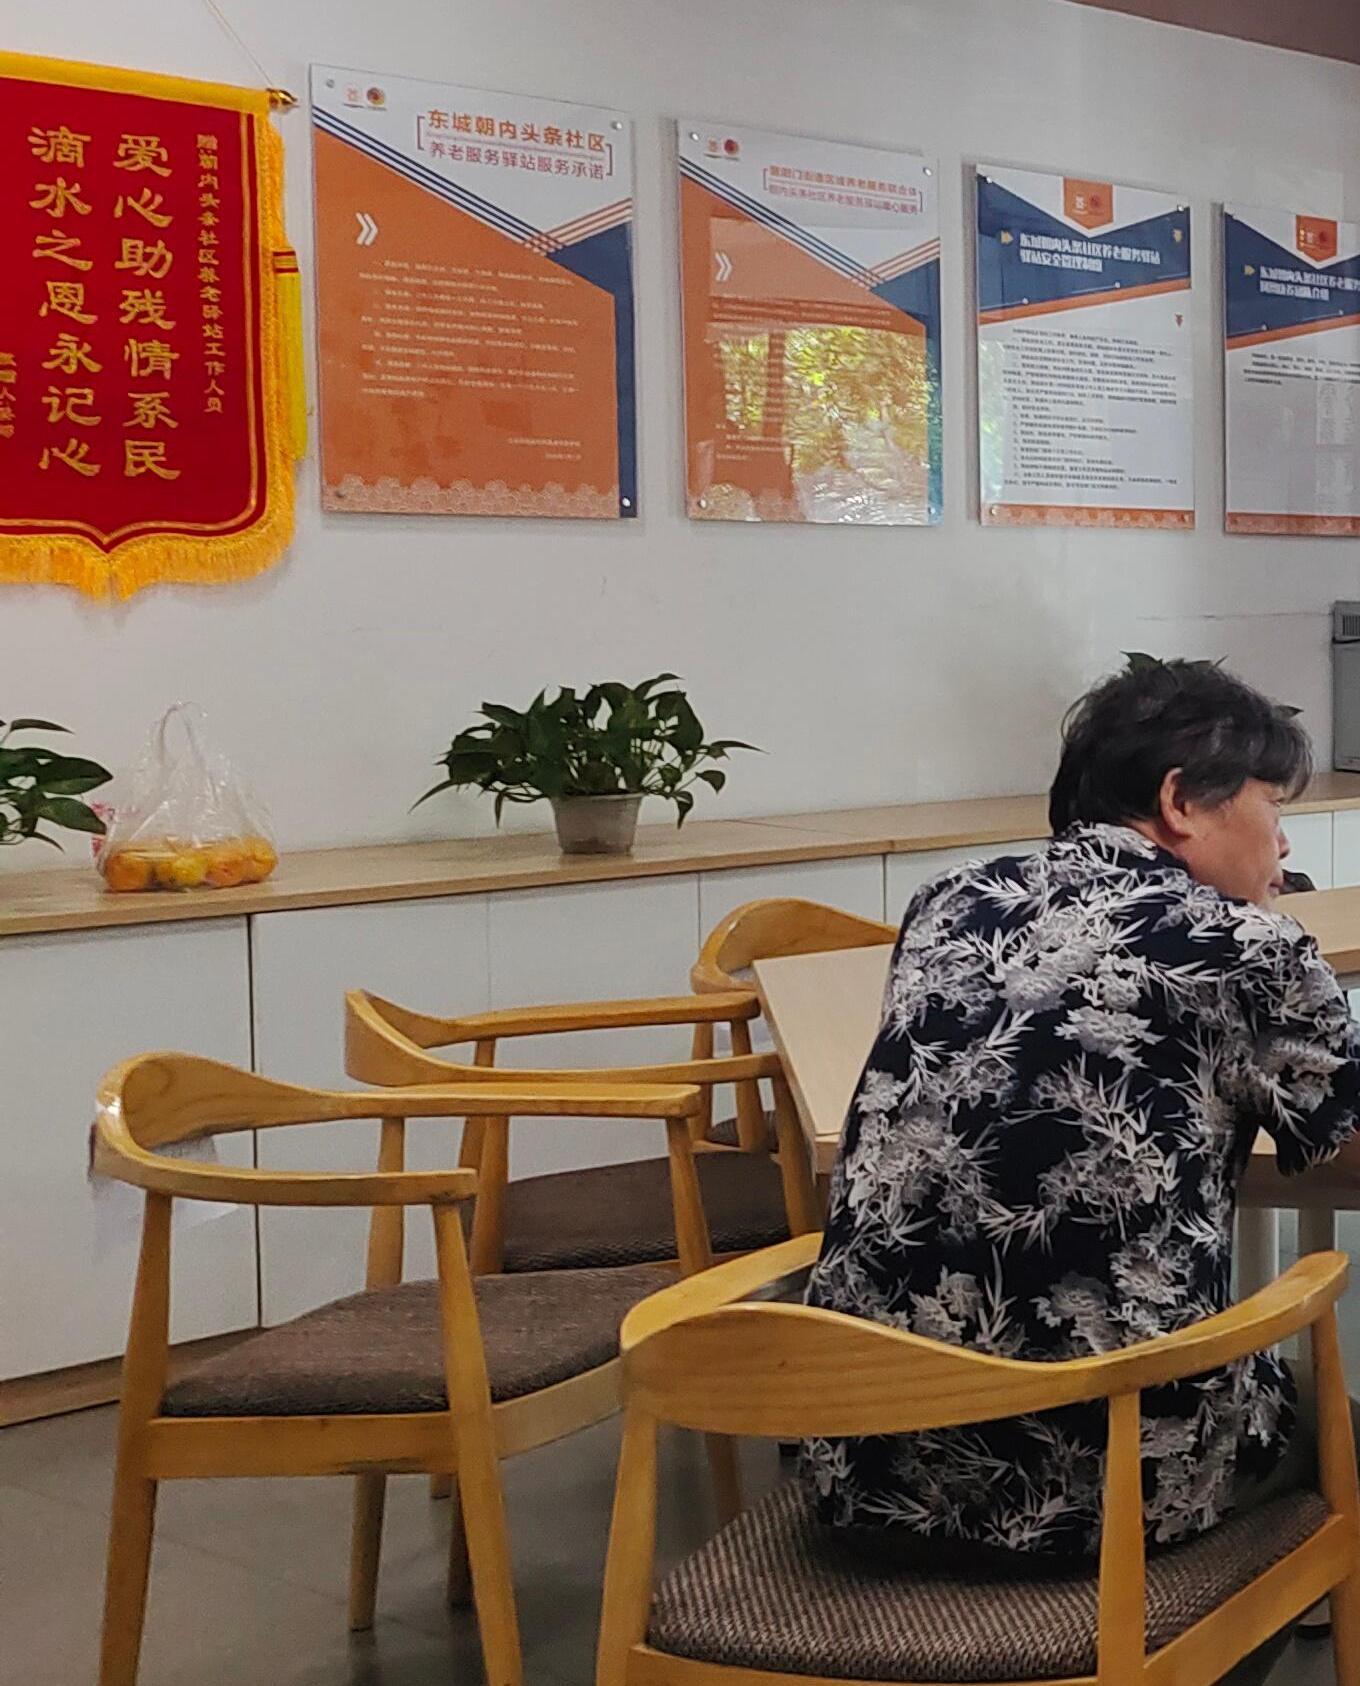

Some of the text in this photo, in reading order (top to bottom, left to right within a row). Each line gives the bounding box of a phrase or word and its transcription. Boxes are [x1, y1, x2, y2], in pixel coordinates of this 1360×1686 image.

[428, 109, 606, 152] 东城朝内头条社区
[430, 141, 605, 180] 养老服务驿站服务承诺
[27, 126, 102, 478] 滴水之恩永记心
[113, 133, 181, 480] 爱心助残情系民
